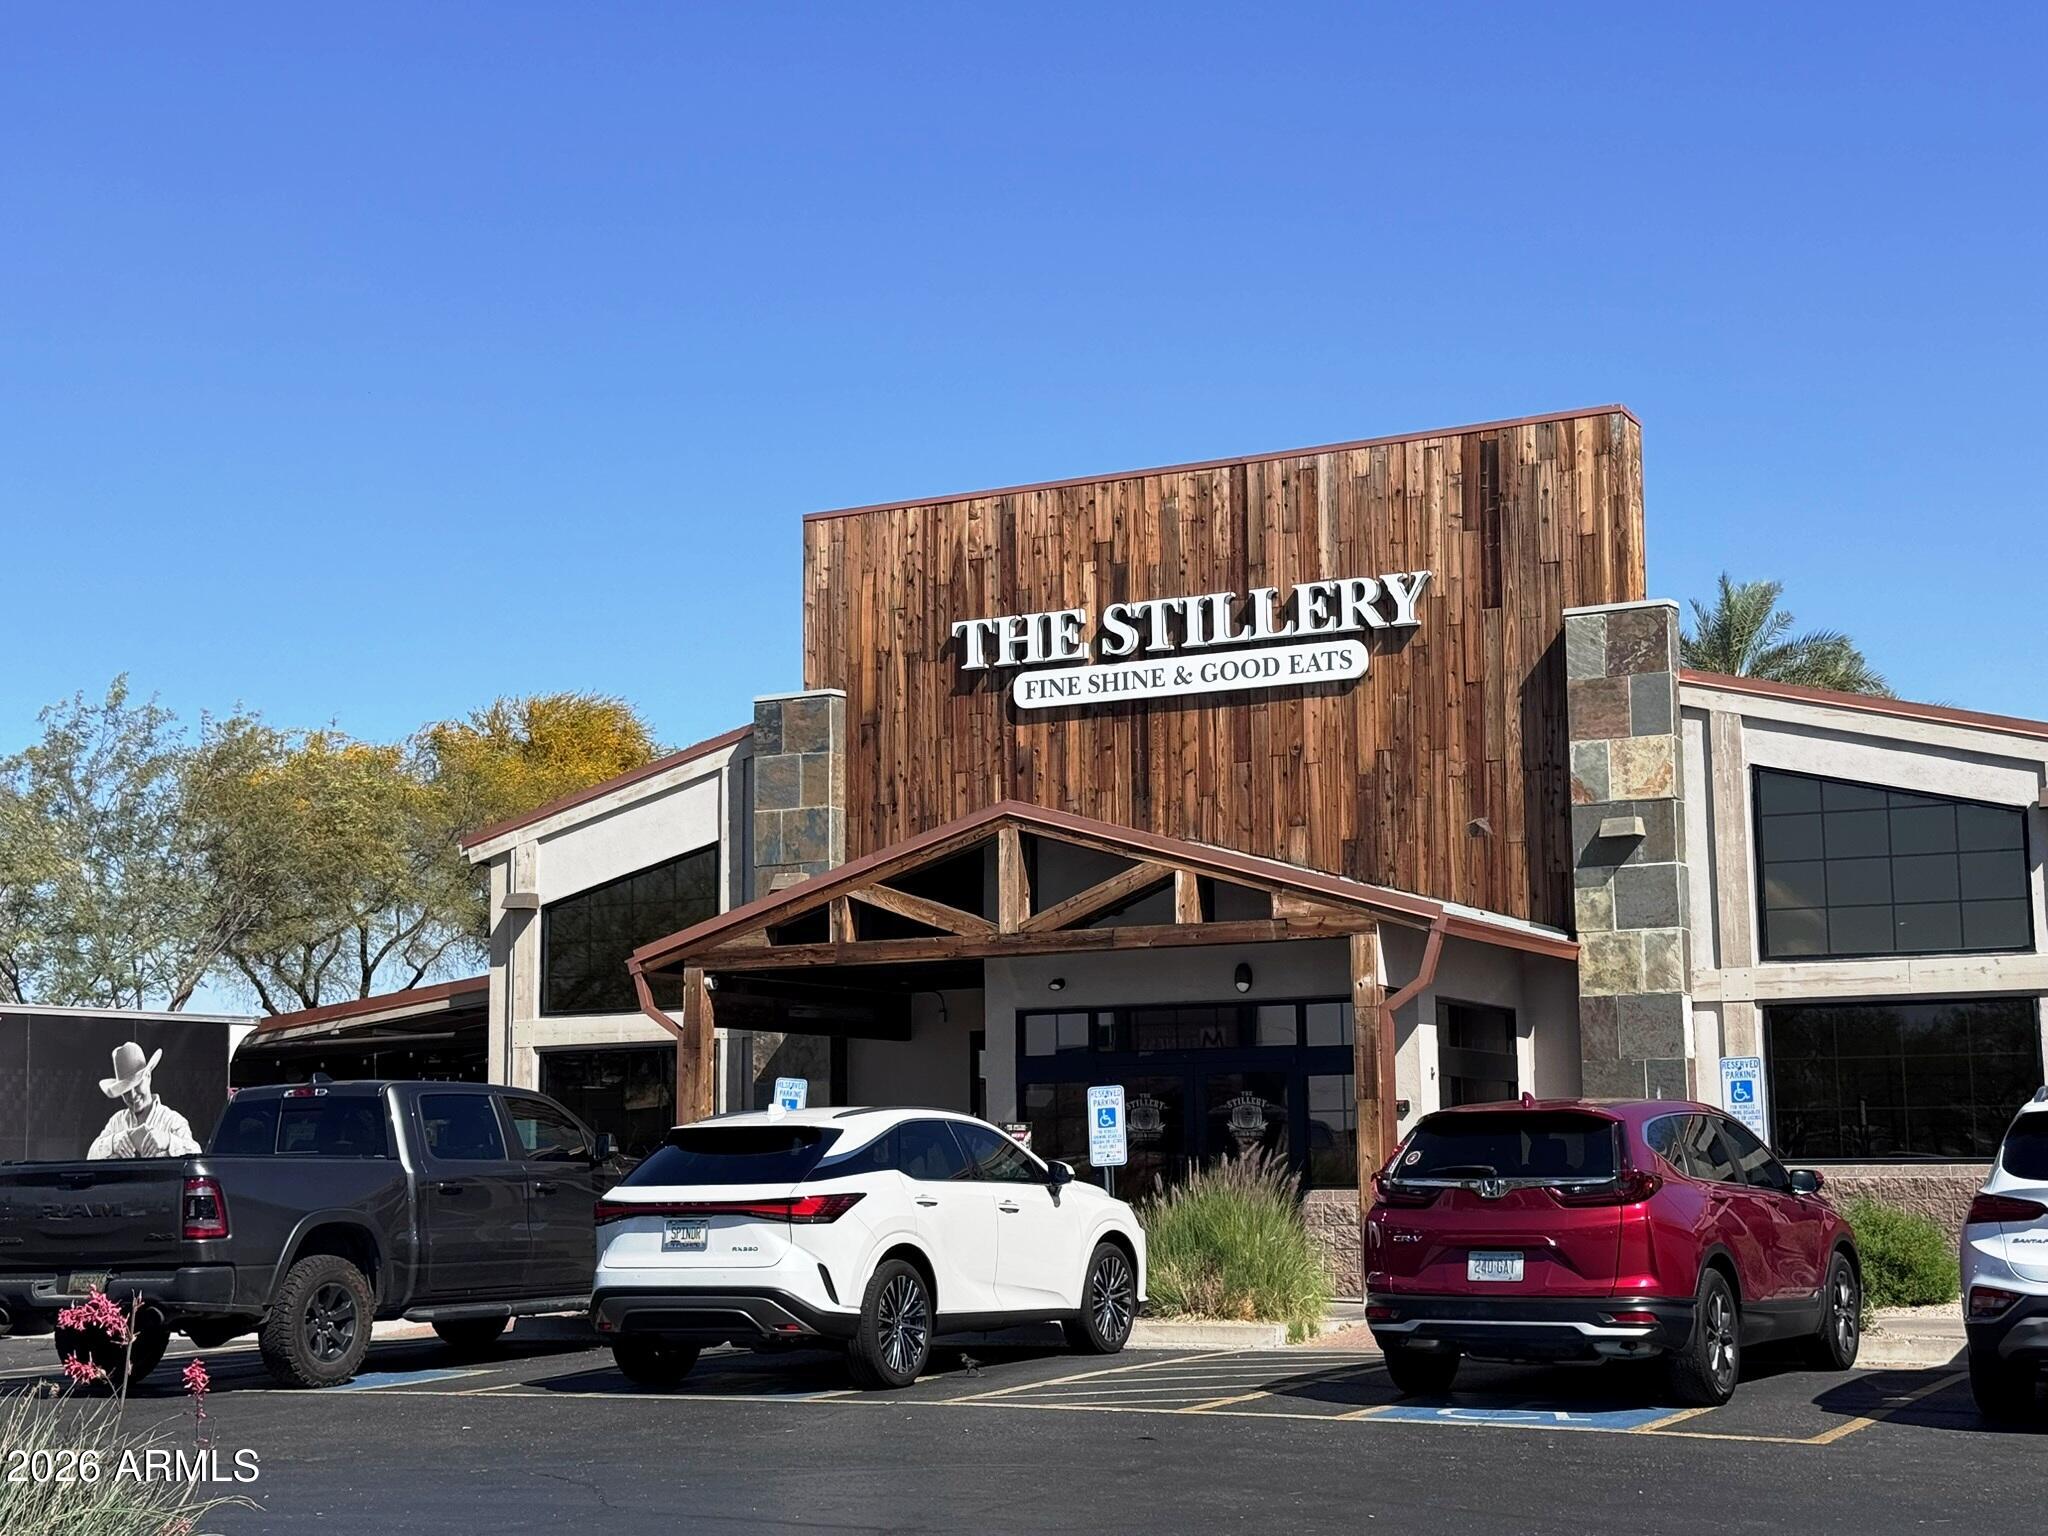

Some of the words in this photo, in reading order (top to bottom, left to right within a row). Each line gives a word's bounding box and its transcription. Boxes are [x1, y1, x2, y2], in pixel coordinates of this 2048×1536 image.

[951, 608, 1089, 671] THE
[1101, 570, 1432, 656] STILLERY
[1024, 676, 1081, 700] FINE
[1087, 668, 1166, 694] SHINE
[1173, 665, 1194, 687] &
[1200, 656, 1280, 684] GOOD
[1289, 649, 1354, 675] EATS
[1721, 1060, 1759, 1070] RESERVED
[1725, 1070, 1757, 1080] PARKING
[1093, 1098, 1119, 1106] PARKING
[1226, 1096, 1267, 1109] STILLERY
[36, 1203, 124, 1218] RAM
